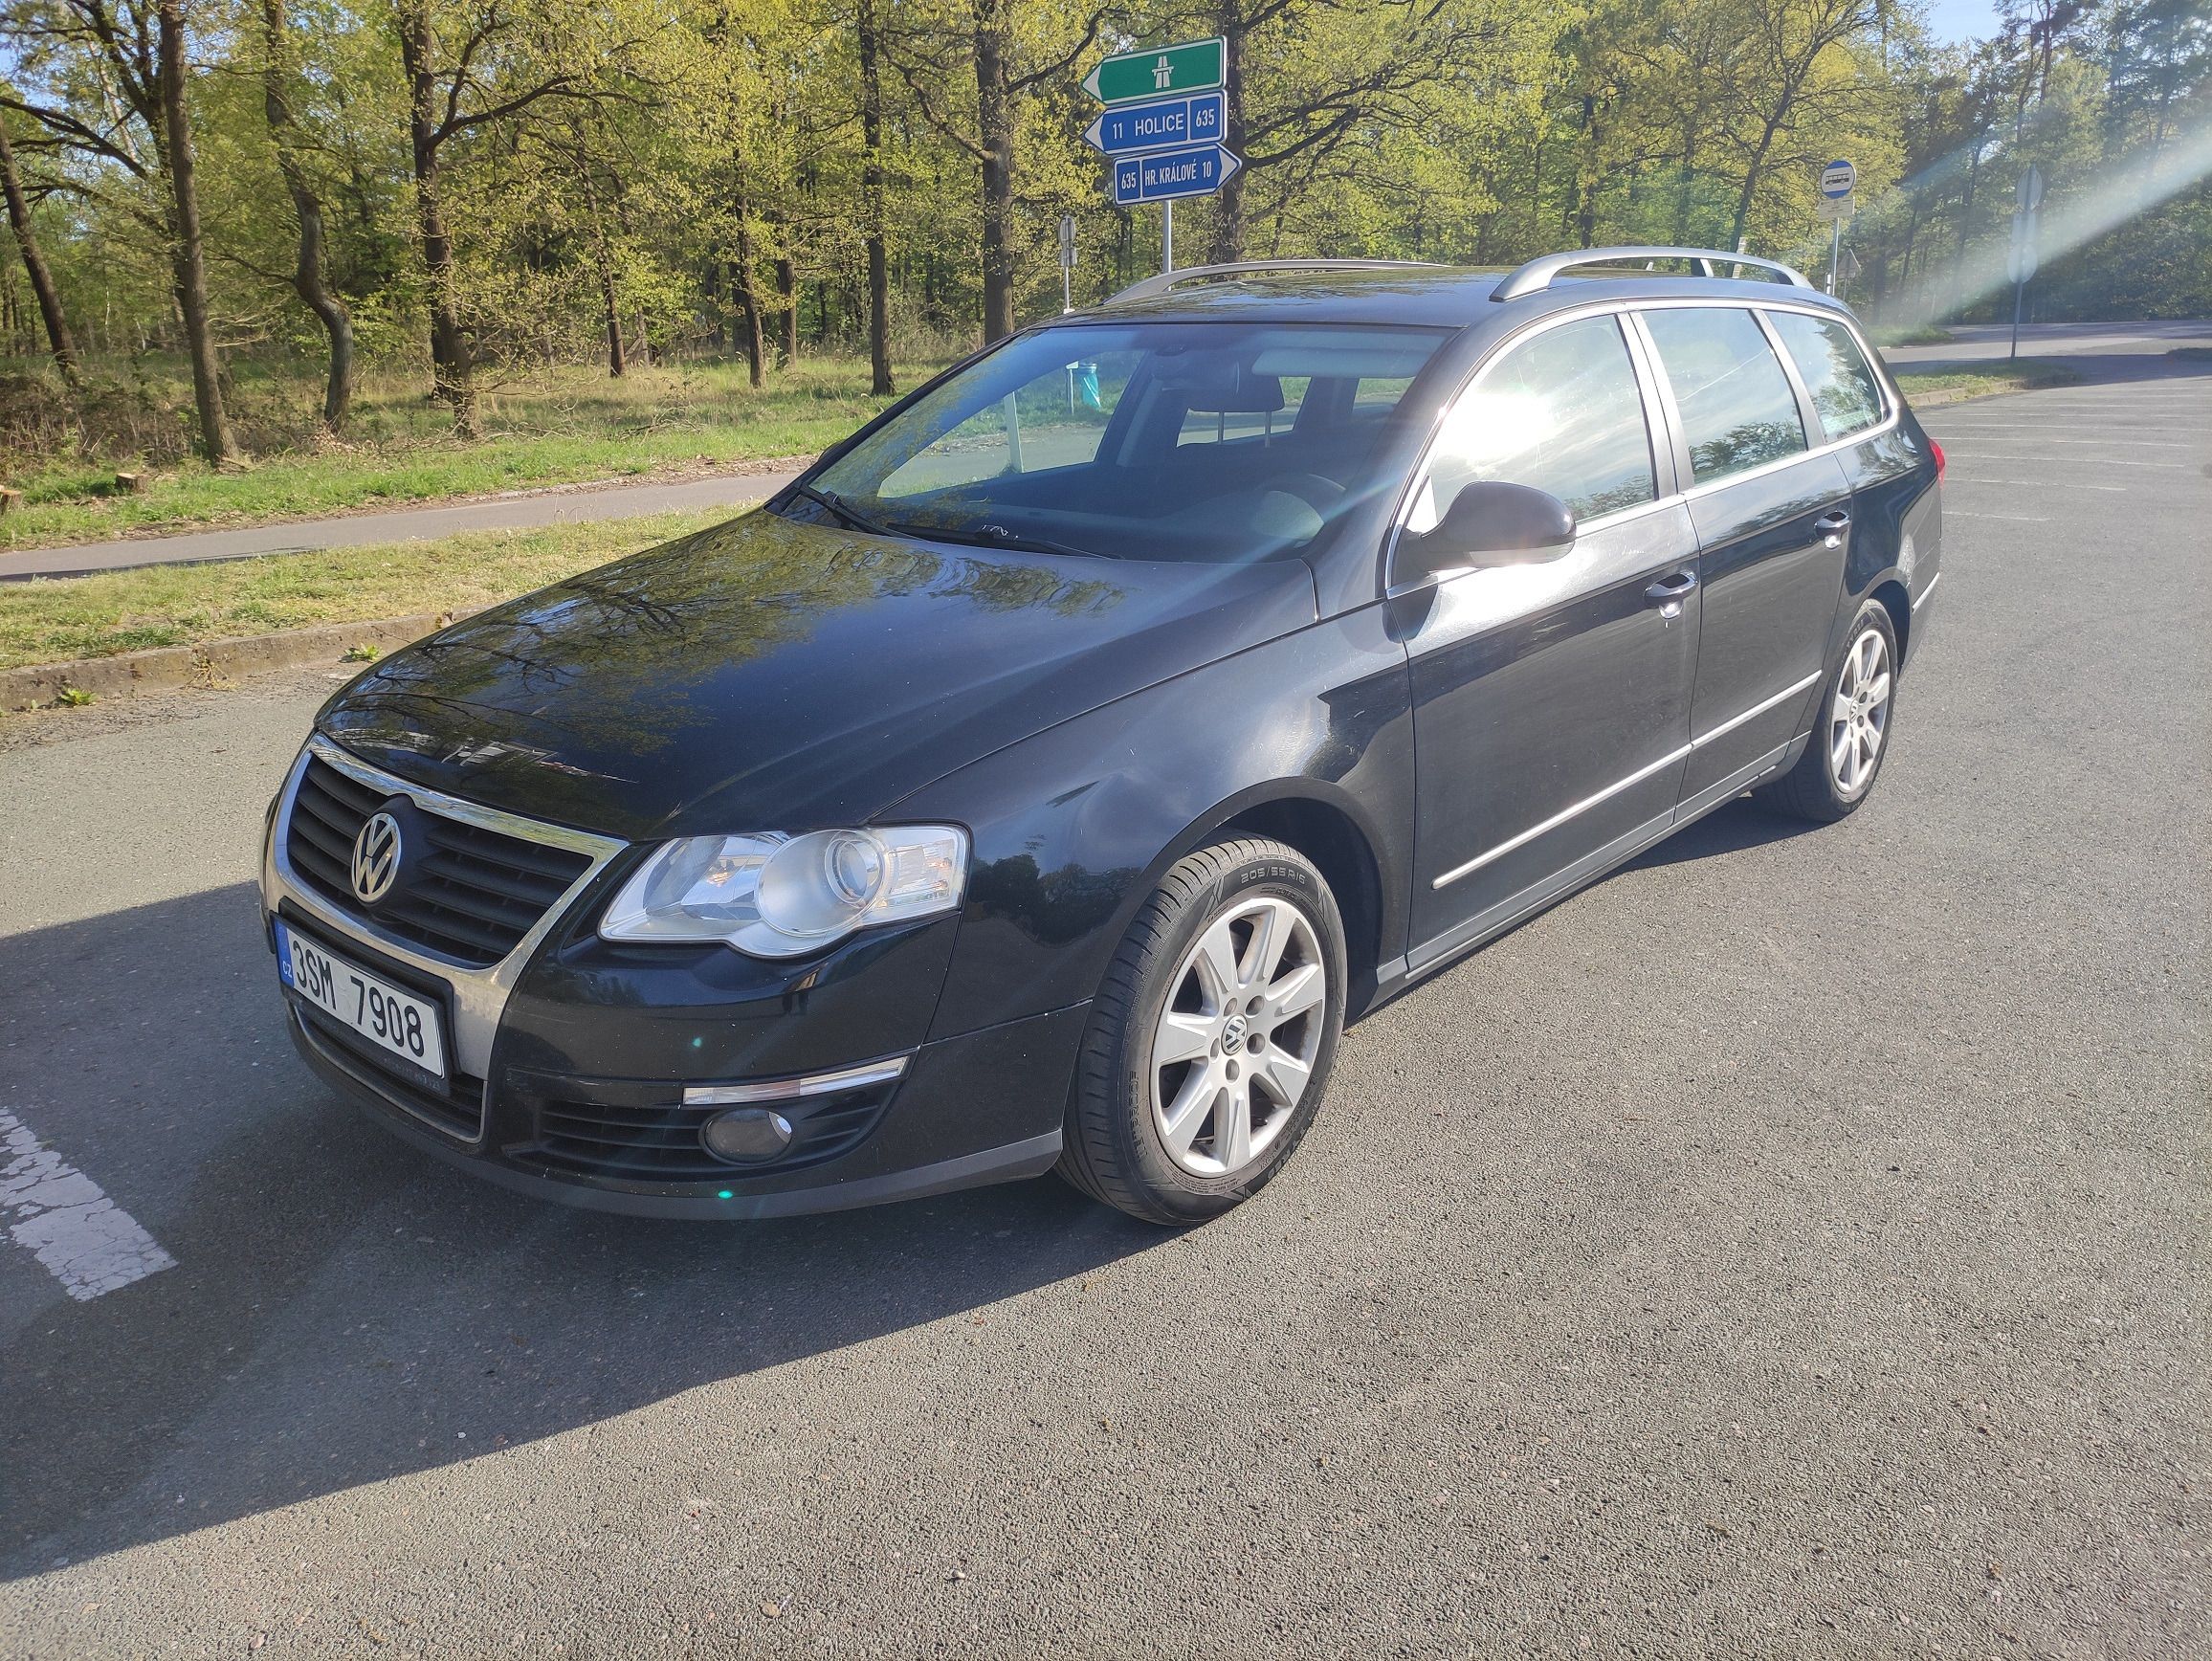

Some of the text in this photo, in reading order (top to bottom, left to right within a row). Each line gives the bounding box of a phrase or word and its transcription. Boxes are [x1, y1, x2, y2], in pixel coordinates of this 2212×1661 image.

[1112, 113, 1184, 140] 11 HOLICE
[1195, 108, 1215, 127] 635
[1121, 172, 1137, 190] 635
[1144, 158, 1212, 187] HR. KRÁLOVÉ 10
[282, 960, 293, 979] CZ
[293, 940, 425, 1058] 3SM 7908
